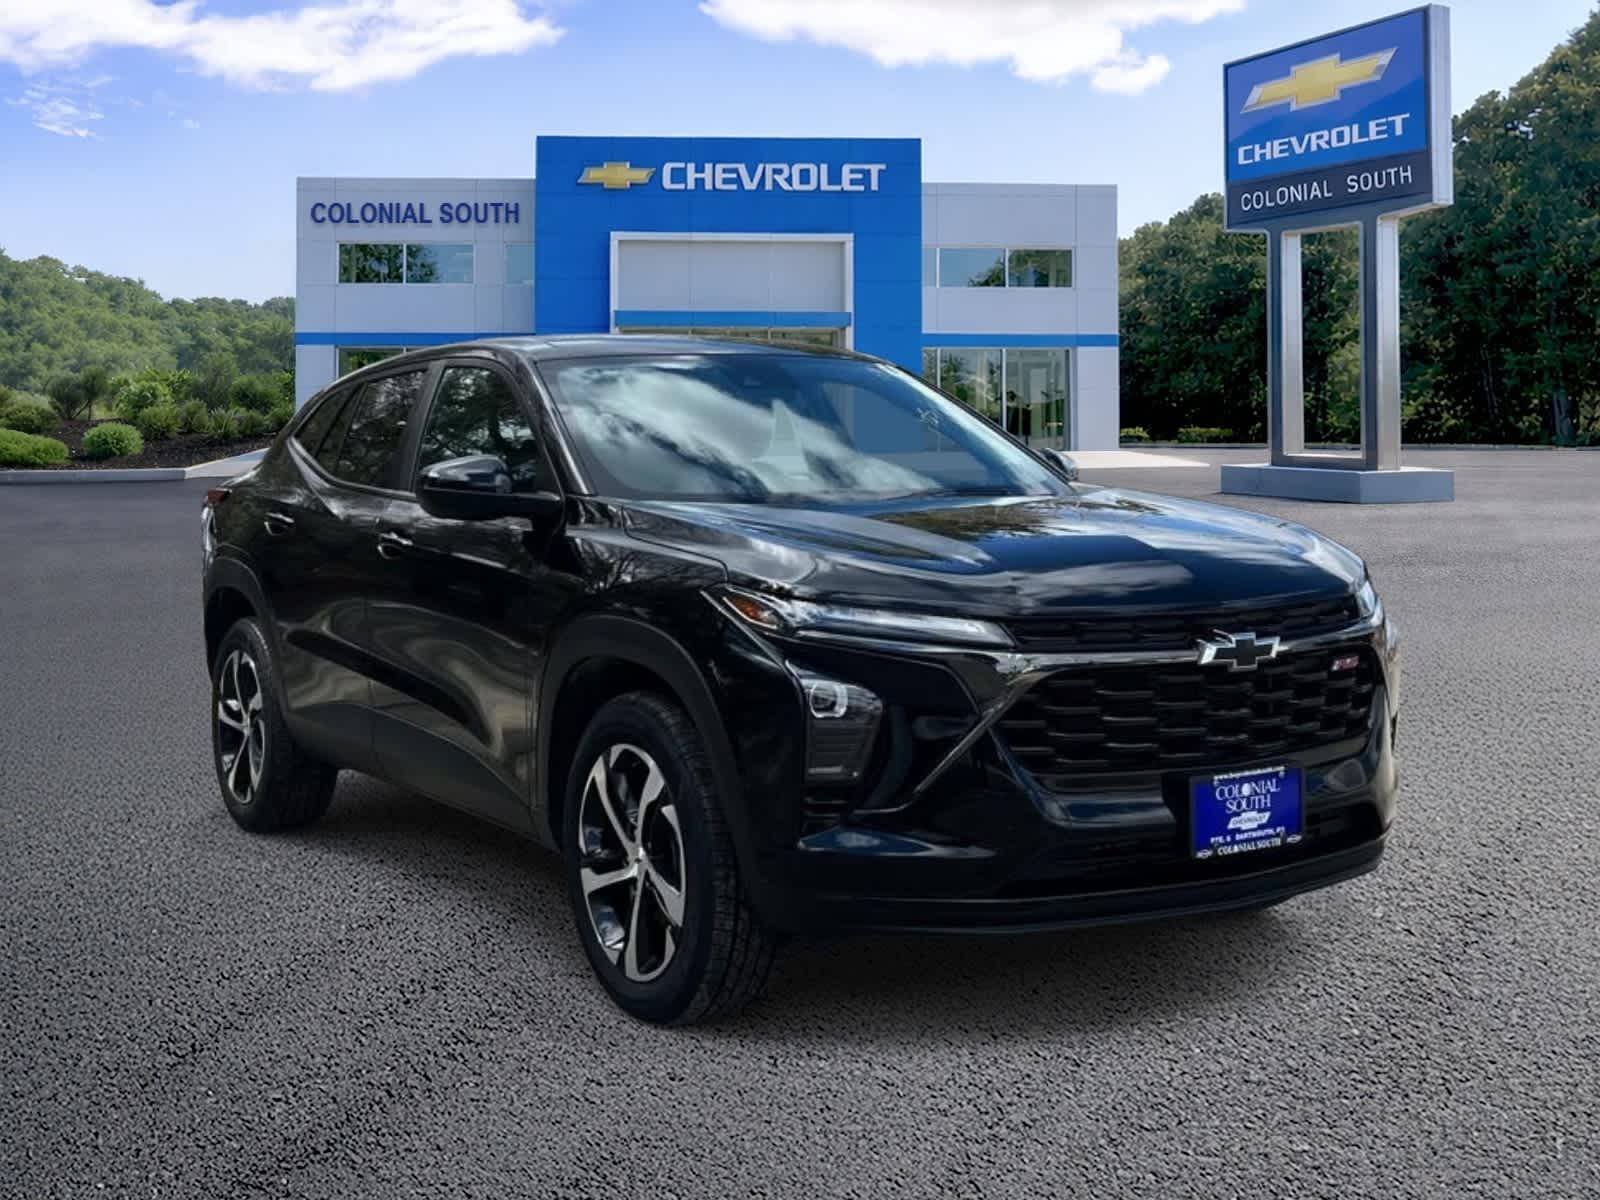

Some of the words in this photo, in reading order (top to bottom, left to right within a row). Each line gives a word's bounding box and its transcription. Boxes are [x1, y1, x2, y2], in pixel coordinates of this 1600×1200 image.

[1237, 113, 1410, 165] CHEVROLET
[661, 162, 886, 192] CHEVROLET
[1240, 180, 1333, 211] COLONIAL
[1346, 165, 1413, 193] SOUTH
[310, 202, 432, 224] COLONIAL
[439, 202, 520, 224] SOUTH
[1216, 778, 1280, 801] COLONIAL
[1225, 795, 1271, 813] SOUTH
